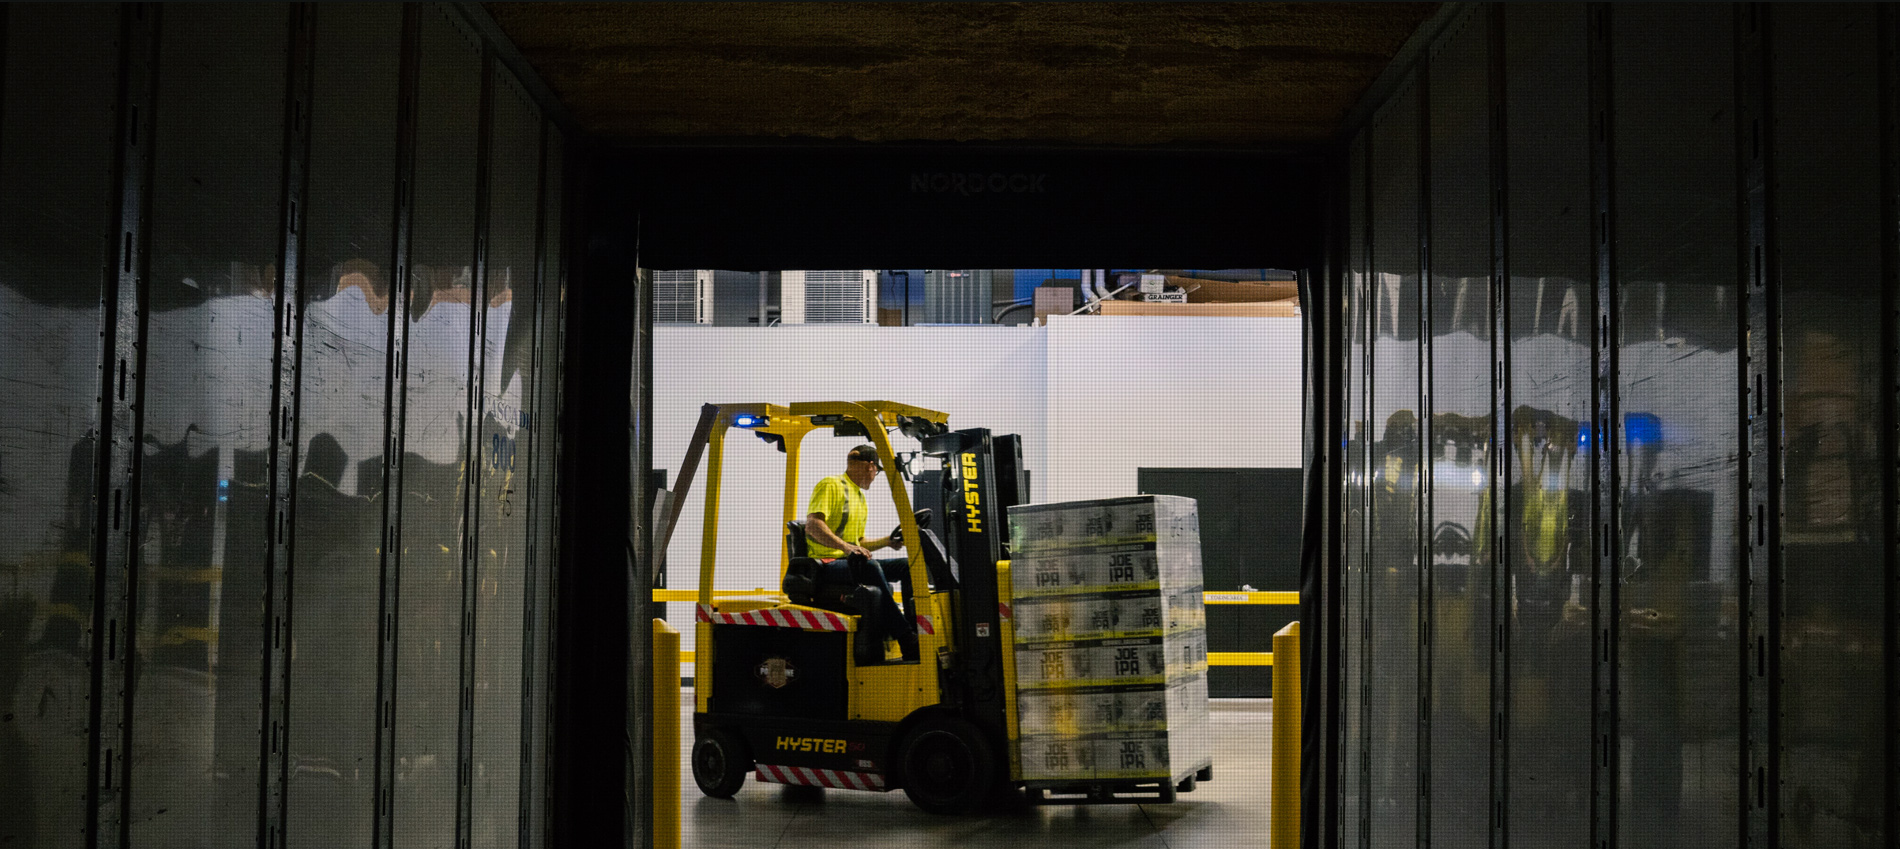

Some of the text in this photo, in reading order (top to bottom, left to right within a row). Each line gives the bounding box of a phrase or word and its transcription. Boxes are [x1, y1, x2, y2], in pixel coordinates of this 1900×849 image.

[910, 172, 1047, 197] NORDOCK
[492, 433, 516, 473] 800
[961, 452, 982, 533] HYSTER
[1136, 514, 1151, 523] JOE
[1136, 522, 1153, 533] IPA
[1036, 559, 1058, 571] JOE
[1109, 554, 1133, 567] JOE
[1036, 572, 1060, 587] IPA
[1109, 567, 1134, 582] IPA
[1142, 608, 1158, 617] JOE
[1142, 617, 1160, 628] IPA
[1040, 651, 1063, 664] JOE
[1115, 648, 1138, 660] JOE
[1041, 664, 1065, 679] IPA
[1115, 661, 1140, 675] IPA
[775, 736, 847, 754] HYSTER
[1045, 743, 1067, 755] JOE
[1120, 741, 1143, 753] JOE
[1045, 755, 1068, 770] IPA
[1120, 754, 1145, 769] IPA
